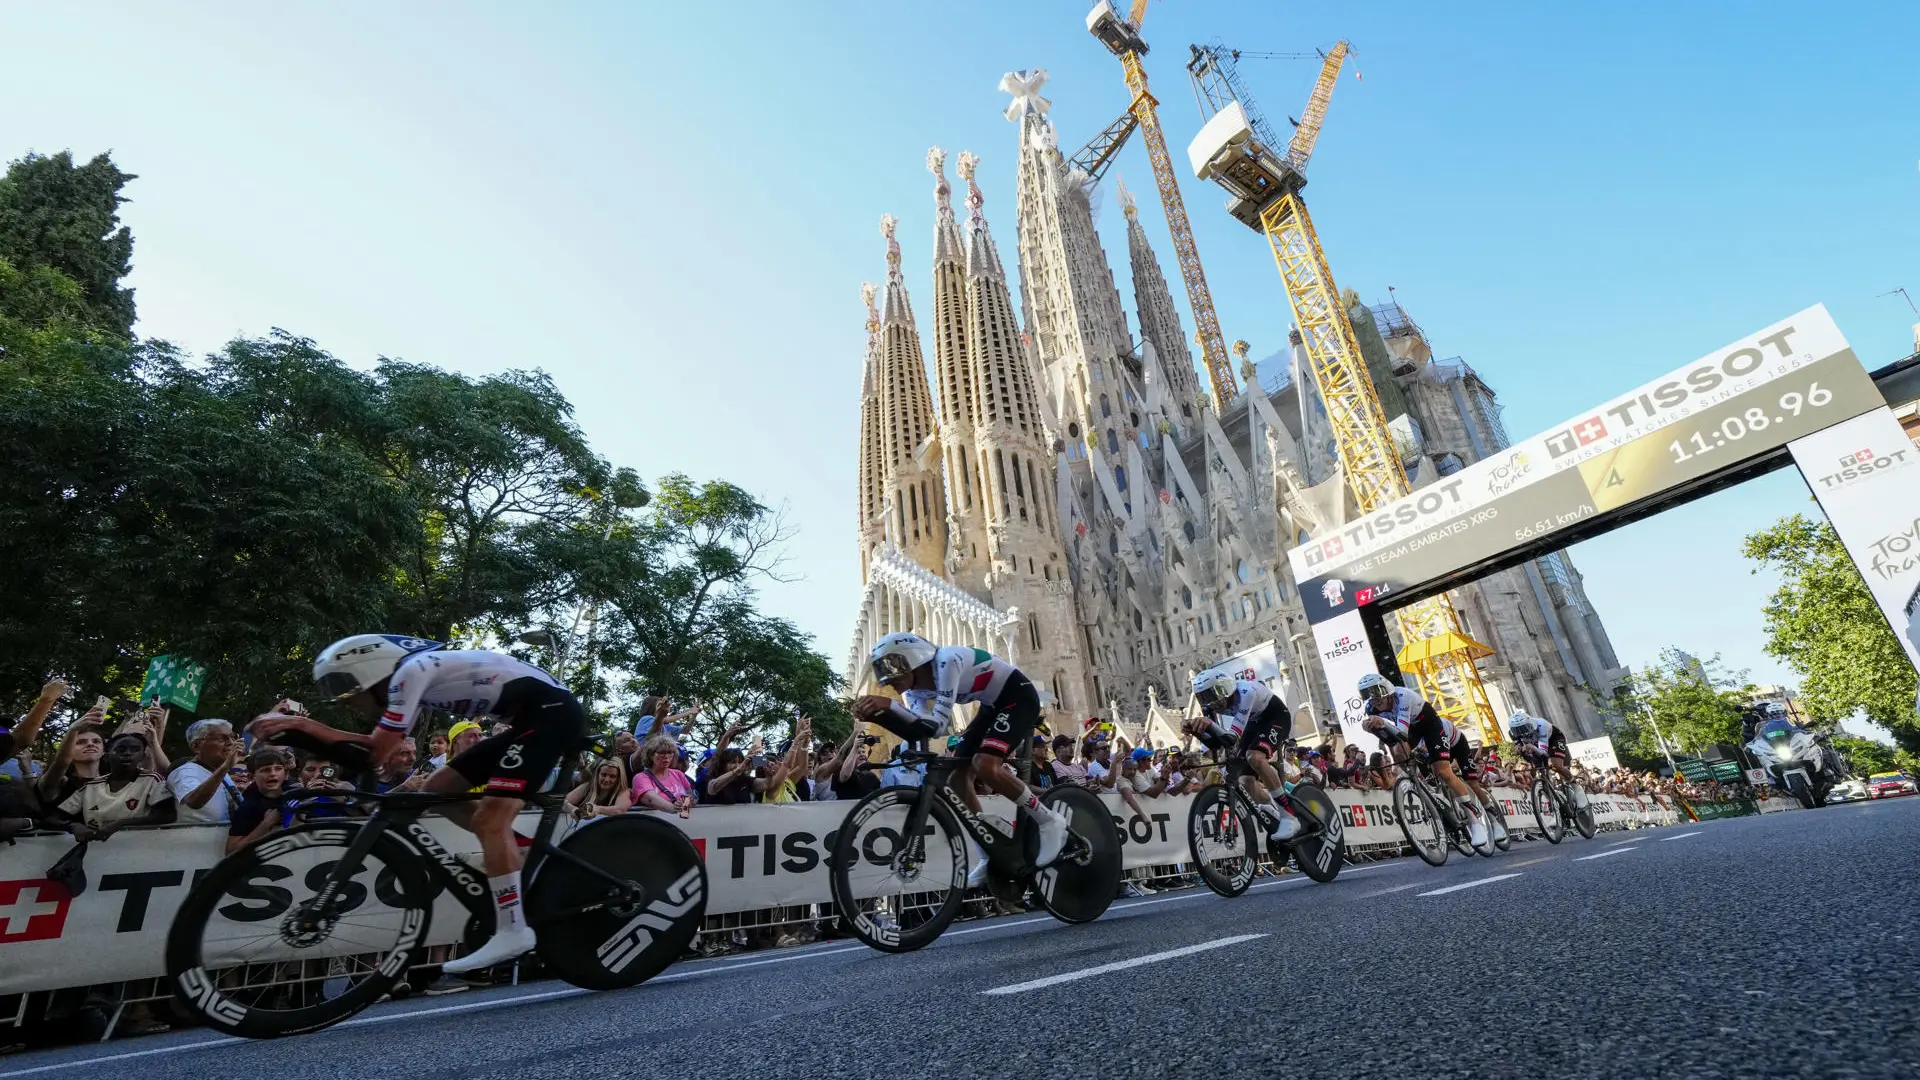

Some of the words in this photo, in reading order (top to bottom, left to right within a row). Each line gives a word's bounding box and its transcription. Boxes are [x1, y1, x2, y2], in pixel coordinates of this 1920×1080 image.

[1607, 326, 1796, 427] TISSOT
[1554, 445, 1602, 471] SWISS
[1610, 407, 1690, 446] WATCHES
[1699, 378, 1755, 408] SINCE
[1768, 353, 1814, 378] 1853
[1669, 381, 1833, 464] 11:08.96
[1606, 467, 1624, 488] 4
[1819, 449, 1907, 488] TISSOT
[1344, 479, 1463, 546] TISSOT
[1351, 561, 1375, 576] UAE
[1375, 546, 1409, 565] TEAM
[1409, 520, 1469, 551] EMIRATES
[1470, 508, 1498, 527] XRG
[1515, 519, 1554, 541] 56.51
[1556, 504, 1594, 524] km/h
[335, 642, 384, 661] MET
[1324, 640, 1364, 659] TISSOT
[944, 786, 994, 844] COLNAGO
[408, 823, 484, 896] COLNAGO
